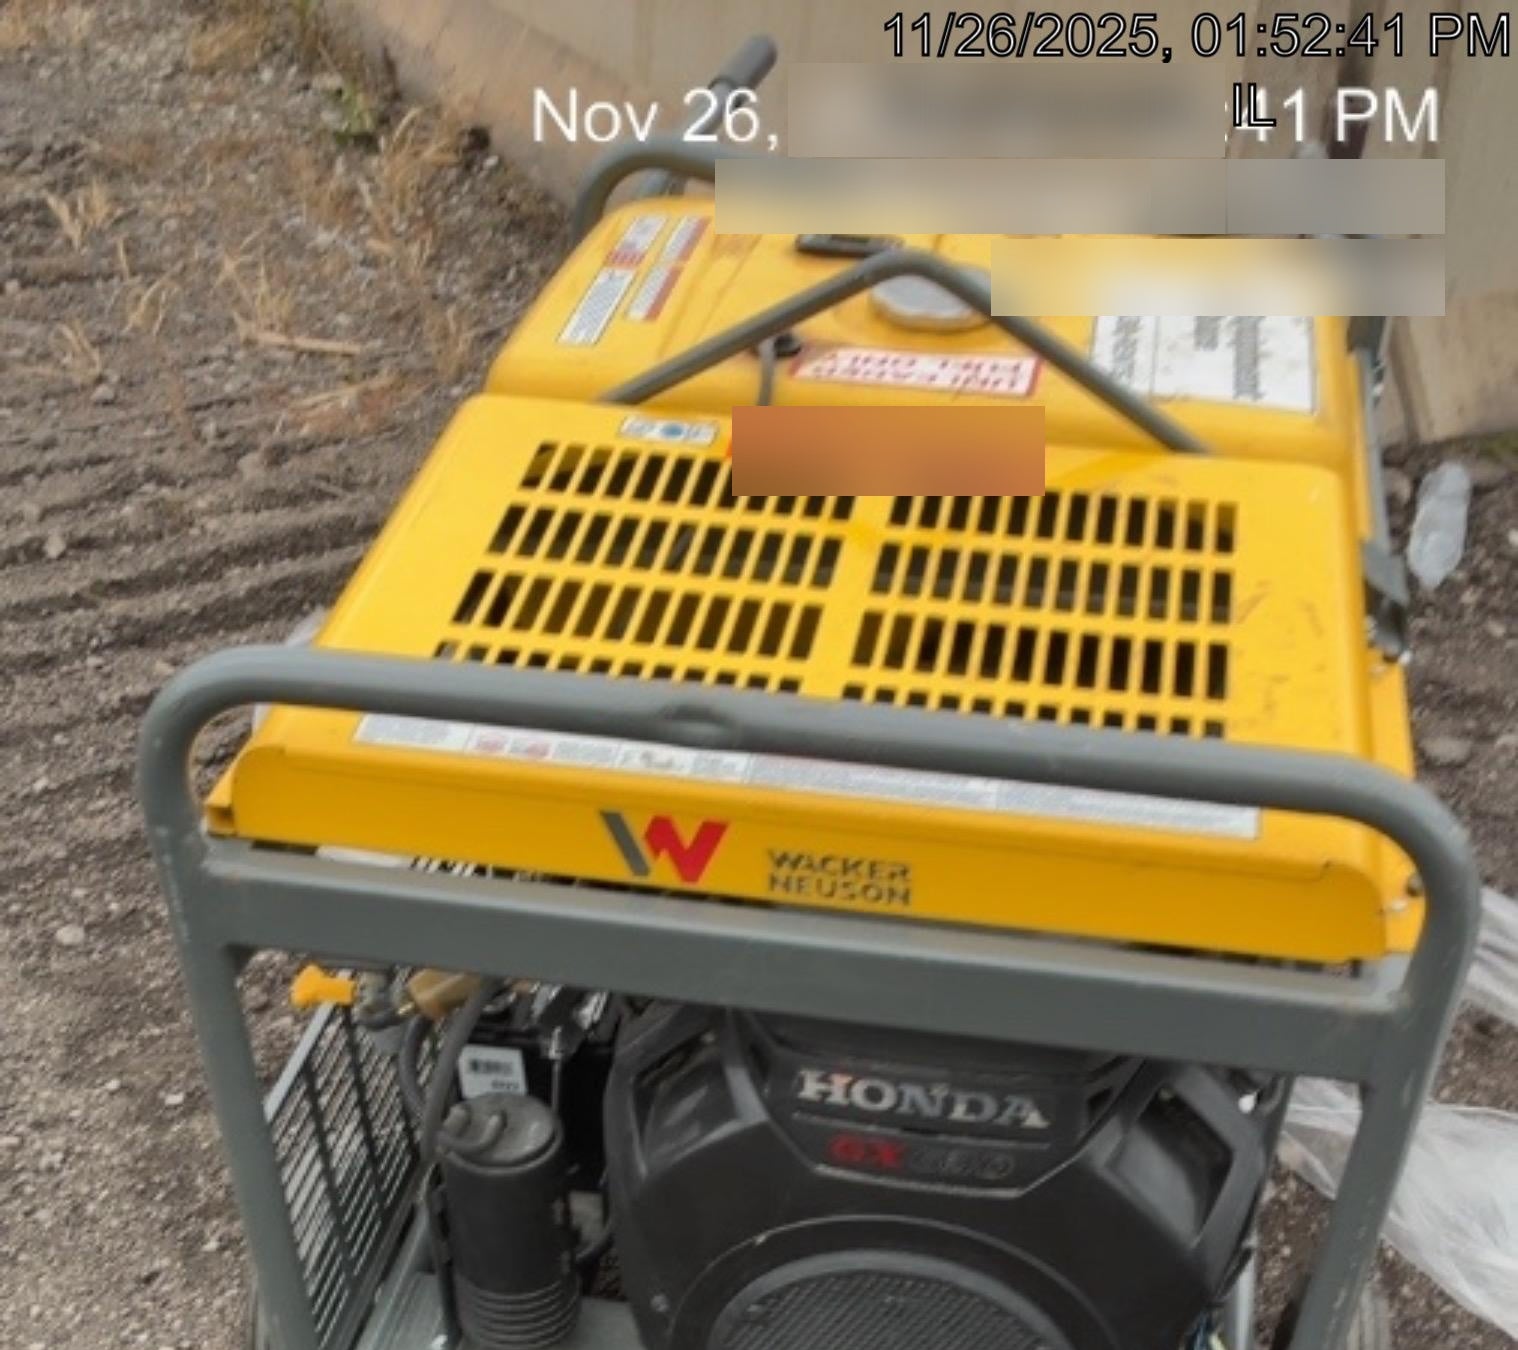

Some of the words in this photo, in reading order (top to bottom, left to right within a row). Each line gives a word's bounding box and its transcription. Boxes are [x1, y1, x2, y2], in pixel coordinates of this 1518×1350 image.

[768, 850, 911, 882] WACKER
[768, 873, 910, 906] NEUSON
[798, 1069, 1049, 1129] HONDA
